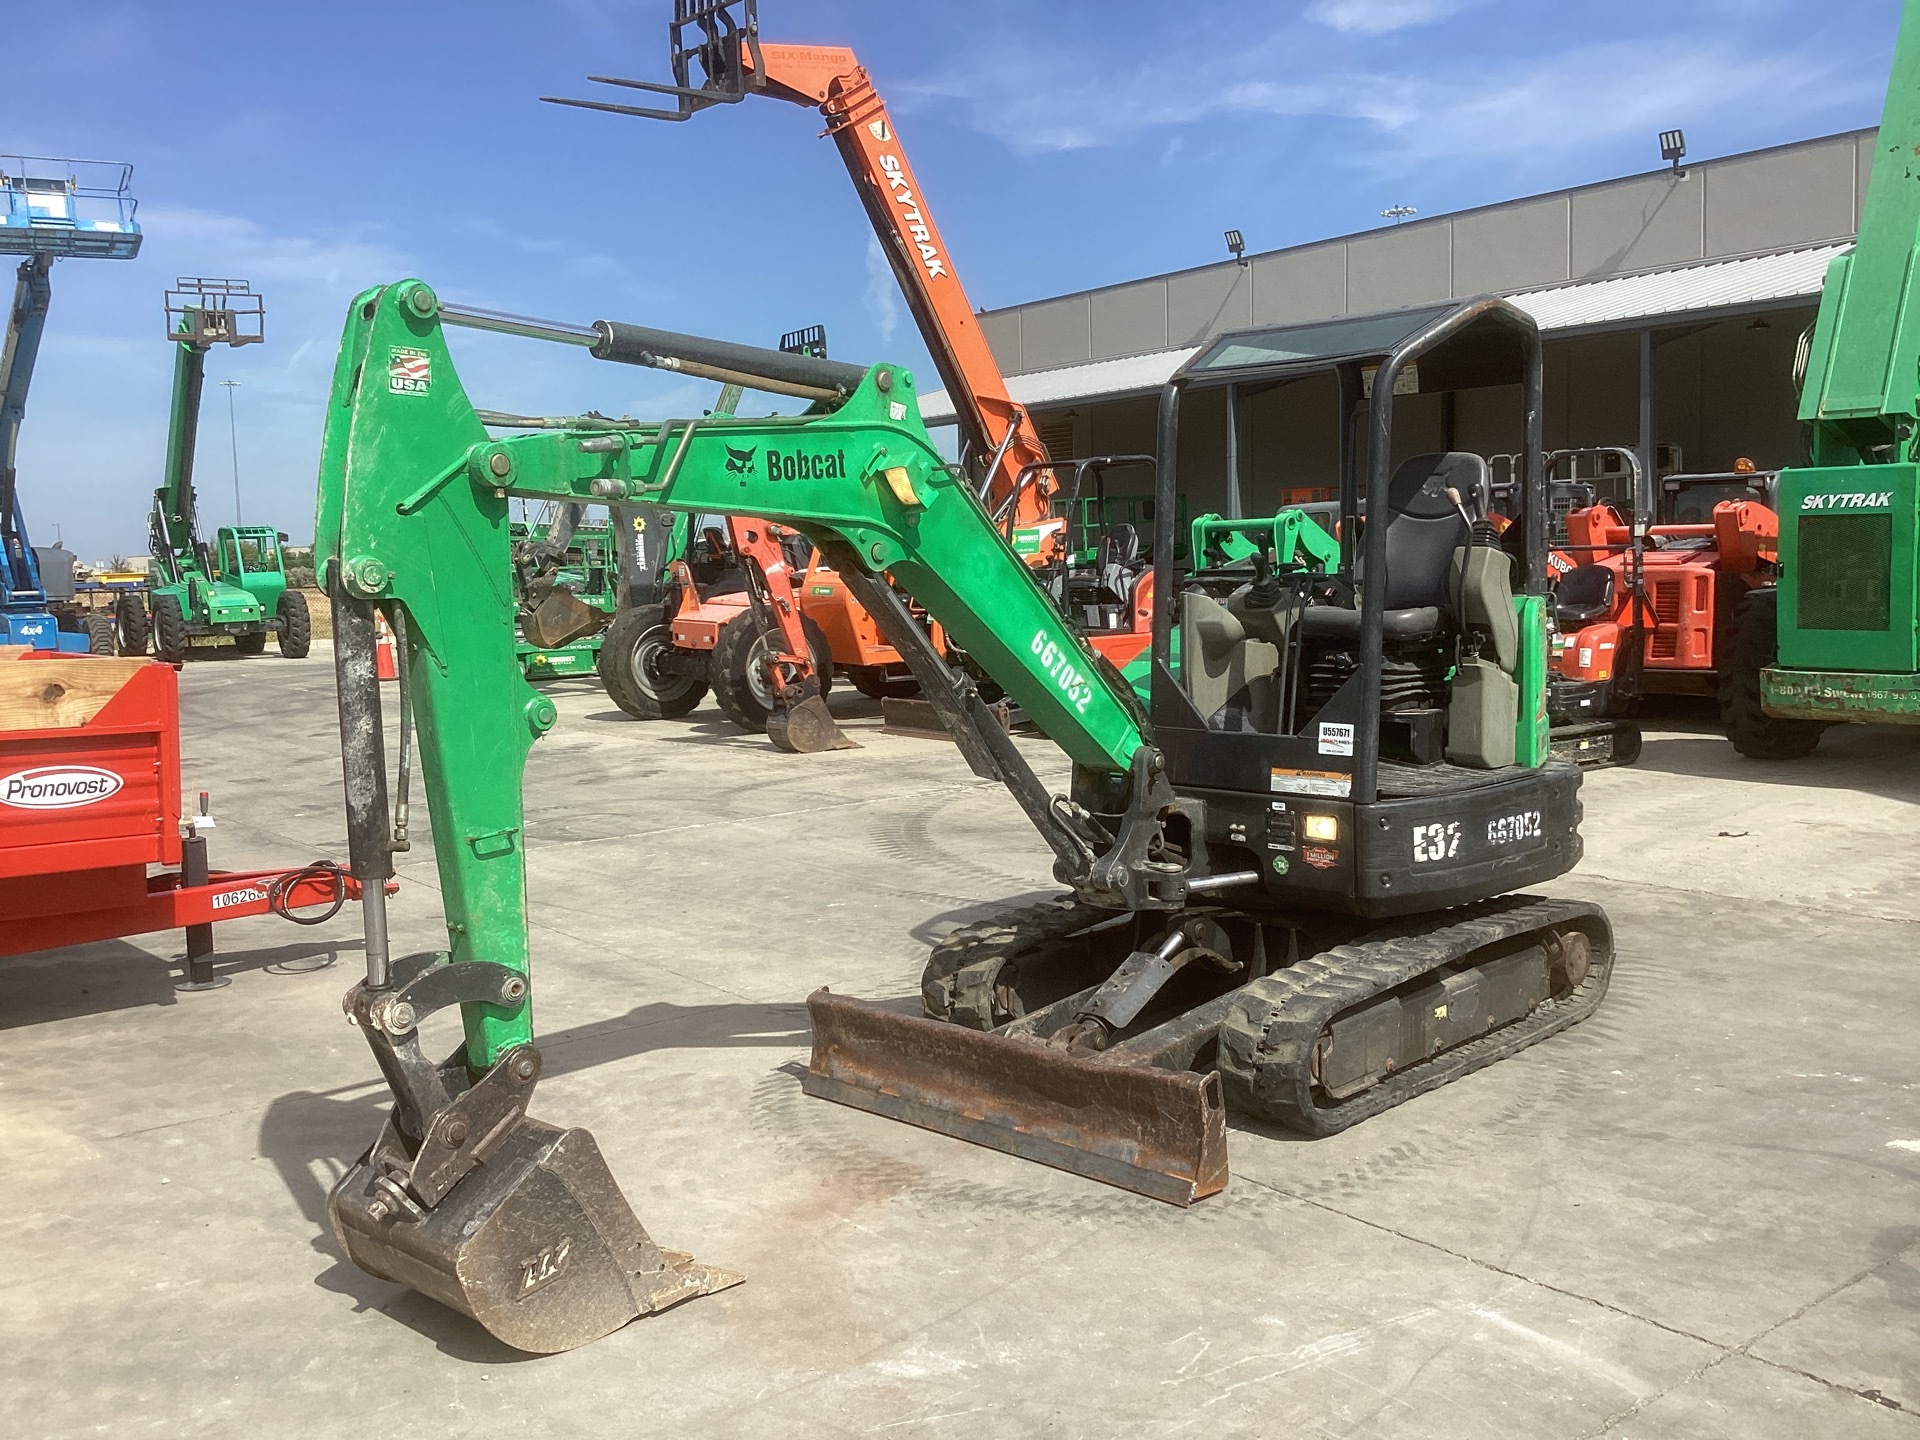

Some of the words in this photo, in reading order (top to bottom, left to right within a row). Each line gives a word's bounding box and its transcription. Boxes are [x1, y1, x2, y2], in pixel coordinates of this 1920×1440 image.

[879, 154, 948, 281] SKYTRAK
[391, 377, 428, 391] USA
[766, 449, 846, 482] Bobcat
[1801, 491, 1894, 509] SKYTRAK
[20, 625, 43, 635] 4x4
[1031, 628, 1092, 714] 667052
[1322, 727, 1350, 738] U557671
[7, 778, 108, 799] Pronovost
[1310, 852, 1335, 861] MILLION
